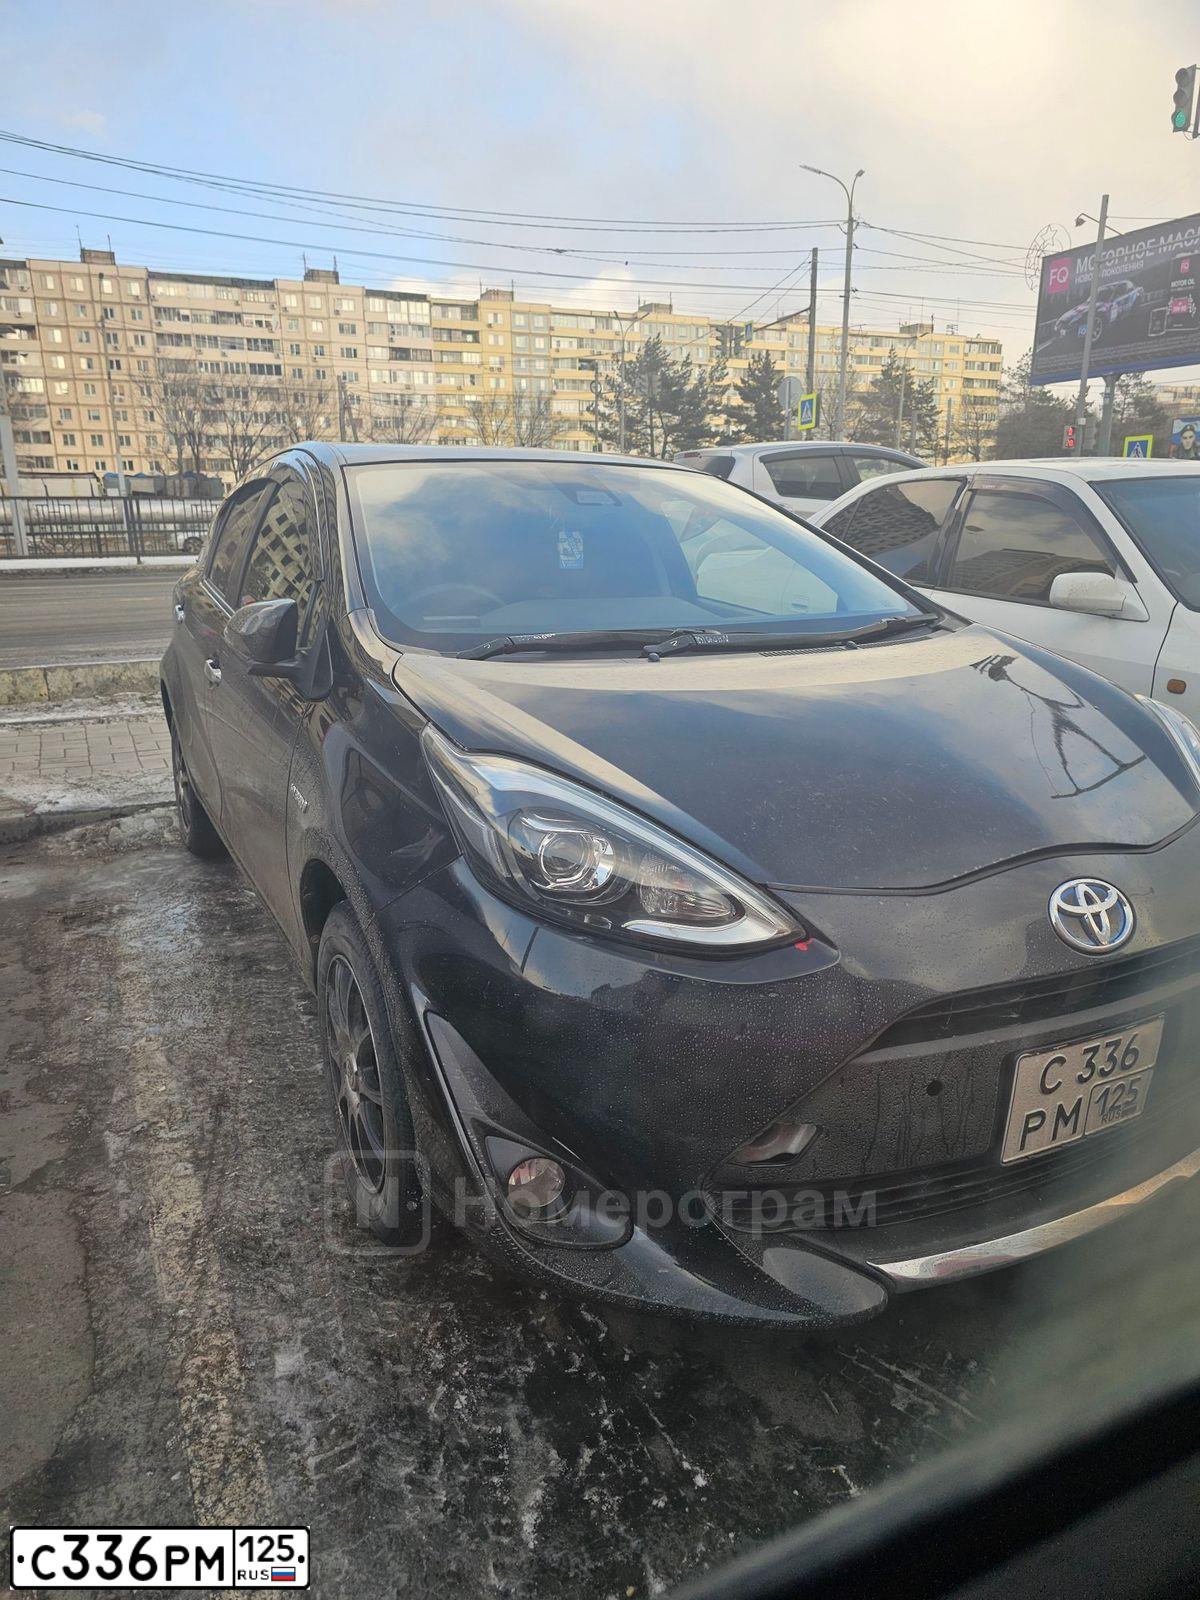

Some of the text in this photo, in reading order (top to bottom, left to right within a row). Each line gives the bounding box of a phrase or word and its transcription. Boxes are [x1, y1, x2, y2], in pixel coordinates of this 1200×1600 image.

[1049, 266, 1069, 287] FQ
[1096, 1077, 1141, 1116] 125
[1019, 1095, 1083, 1151] РМ
[1101, 1109, 1122, 1124] RUS
